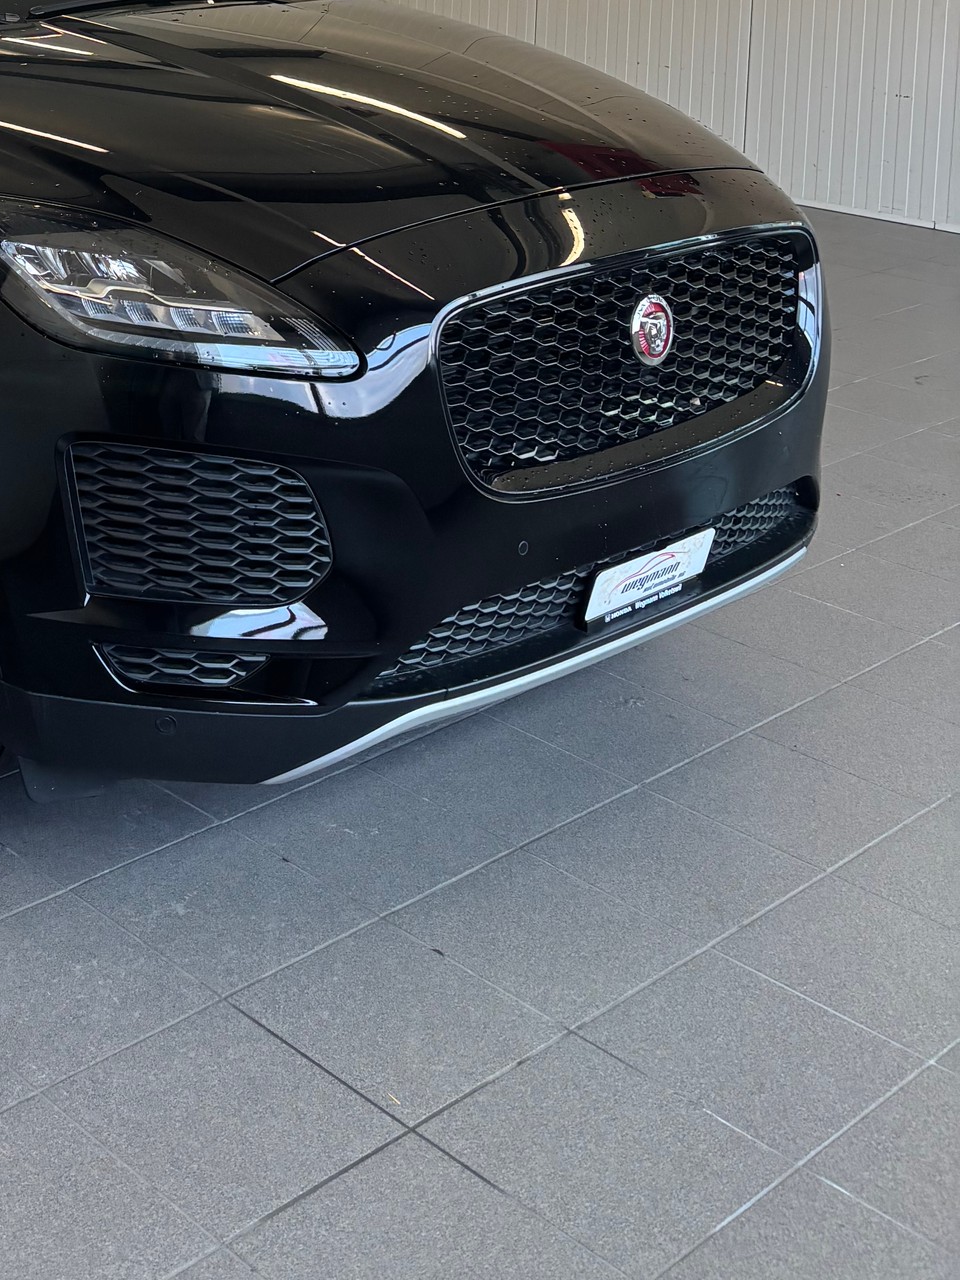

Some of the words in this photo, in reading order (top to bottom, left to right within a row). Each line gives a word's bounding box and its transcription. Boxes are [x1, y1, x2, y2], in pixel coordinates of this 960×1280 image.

[621, 562, 681, 594] wegmann
[611, 606, 633, 620] HONDA
[635, 594, 659, 610] Wegmann
